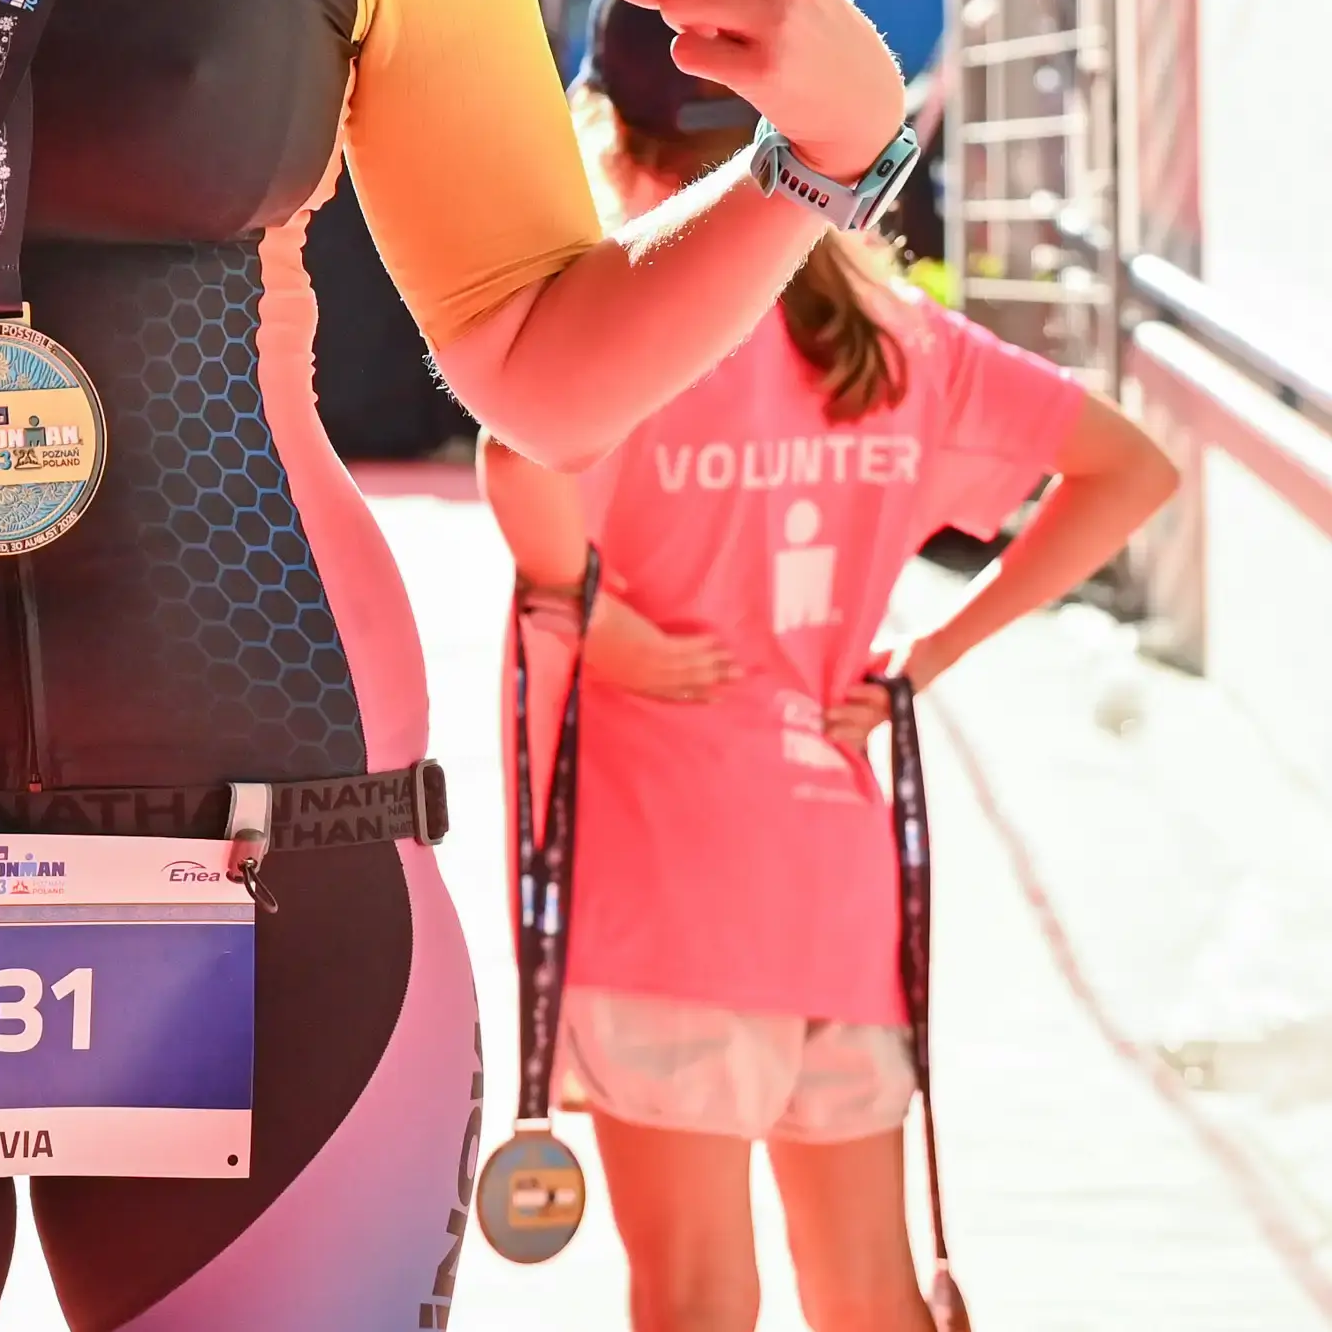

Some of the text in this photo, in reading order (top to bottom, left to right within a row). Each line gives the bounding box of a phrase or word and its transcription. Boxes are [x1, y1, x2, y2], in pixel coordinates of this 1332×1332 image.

[43, 458, 81, 468] POLAND
[169, 868, 221, 882] Enea
[32, 887, 65, 895] POLAND
